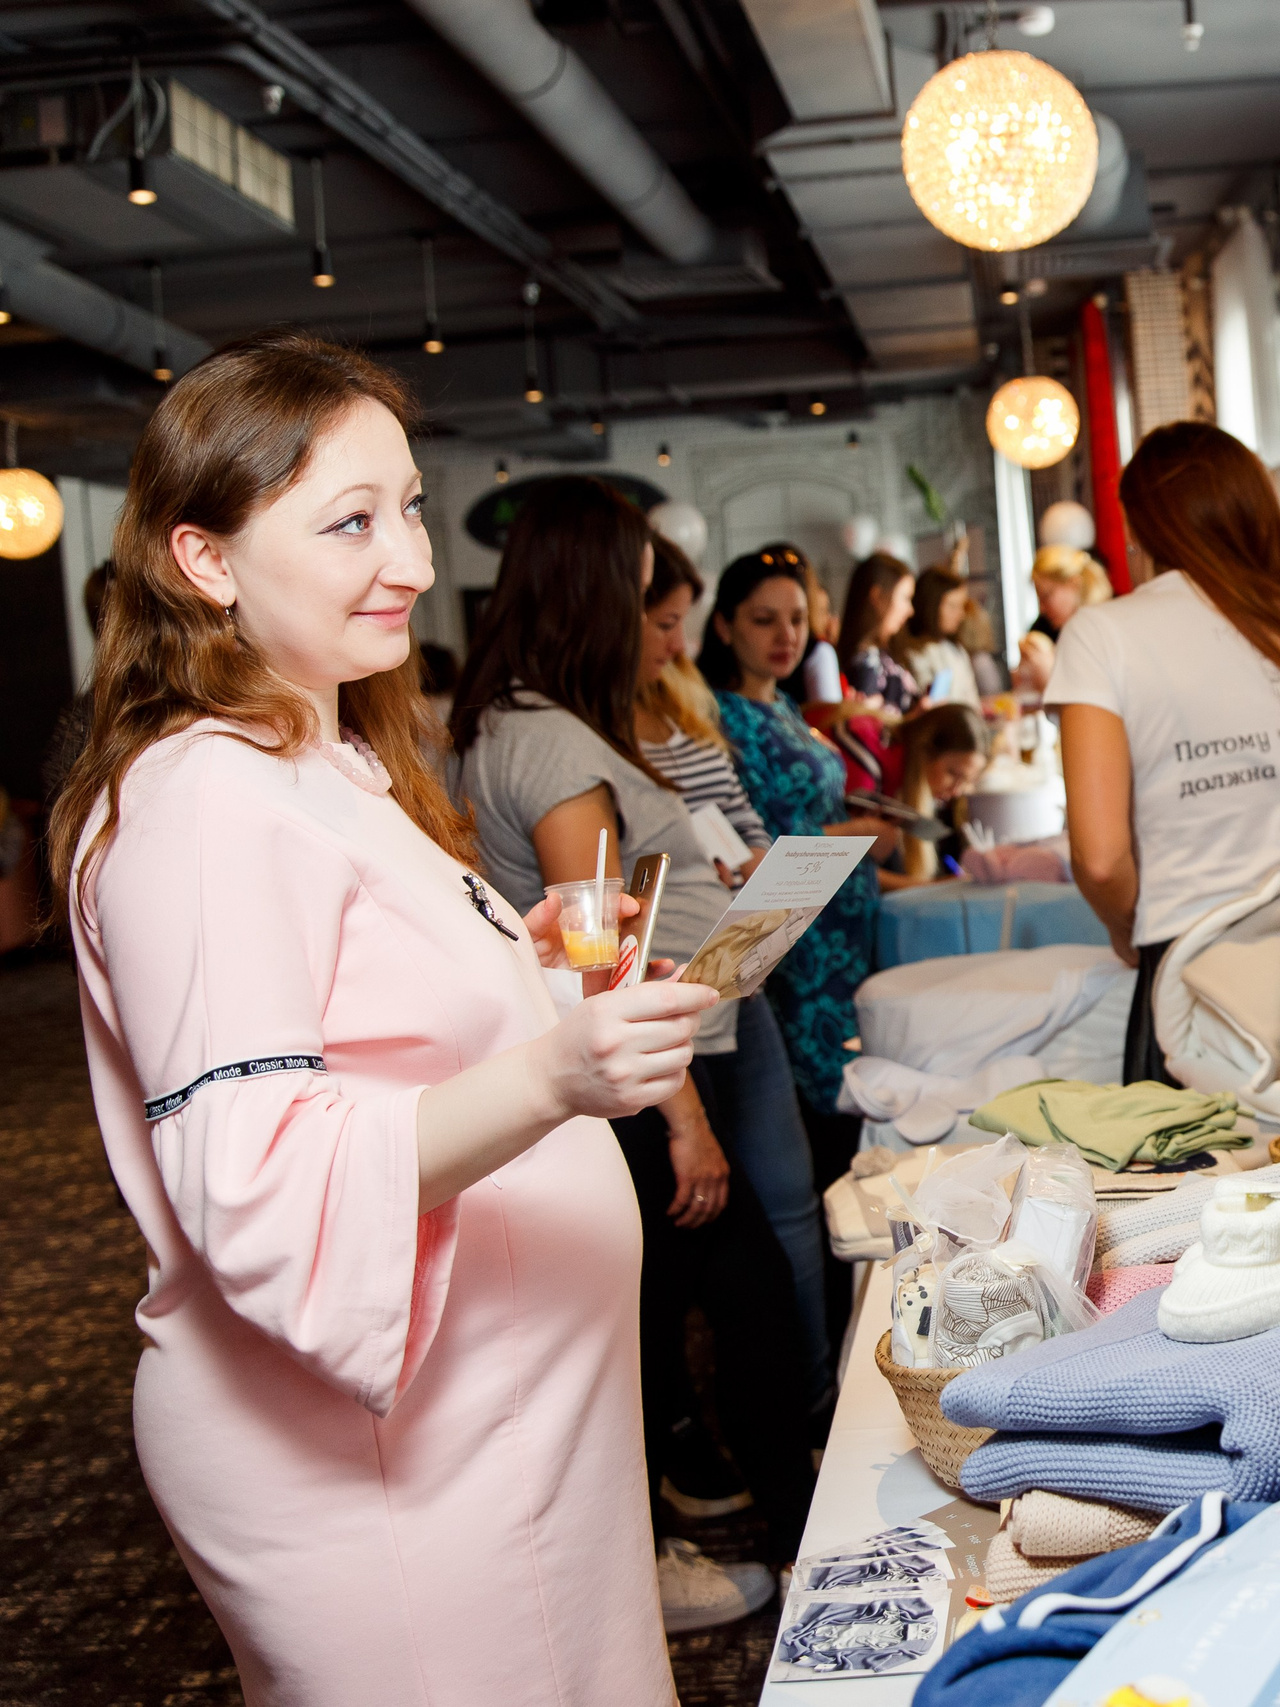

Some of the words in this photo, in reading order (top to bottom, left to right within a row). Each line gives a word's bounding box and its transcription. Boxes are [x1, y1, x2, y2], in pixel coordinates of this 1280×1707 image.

[1175, 731, 1271, 762] Потому
[1180, 764, 1276, 799] должна
[797, 861, 824, 875] -5%
[213, 1065, 242, 1081] Mode
[248, 1058, 284, 1074] Classic
[284, 1057, 309, 1069] Mode
